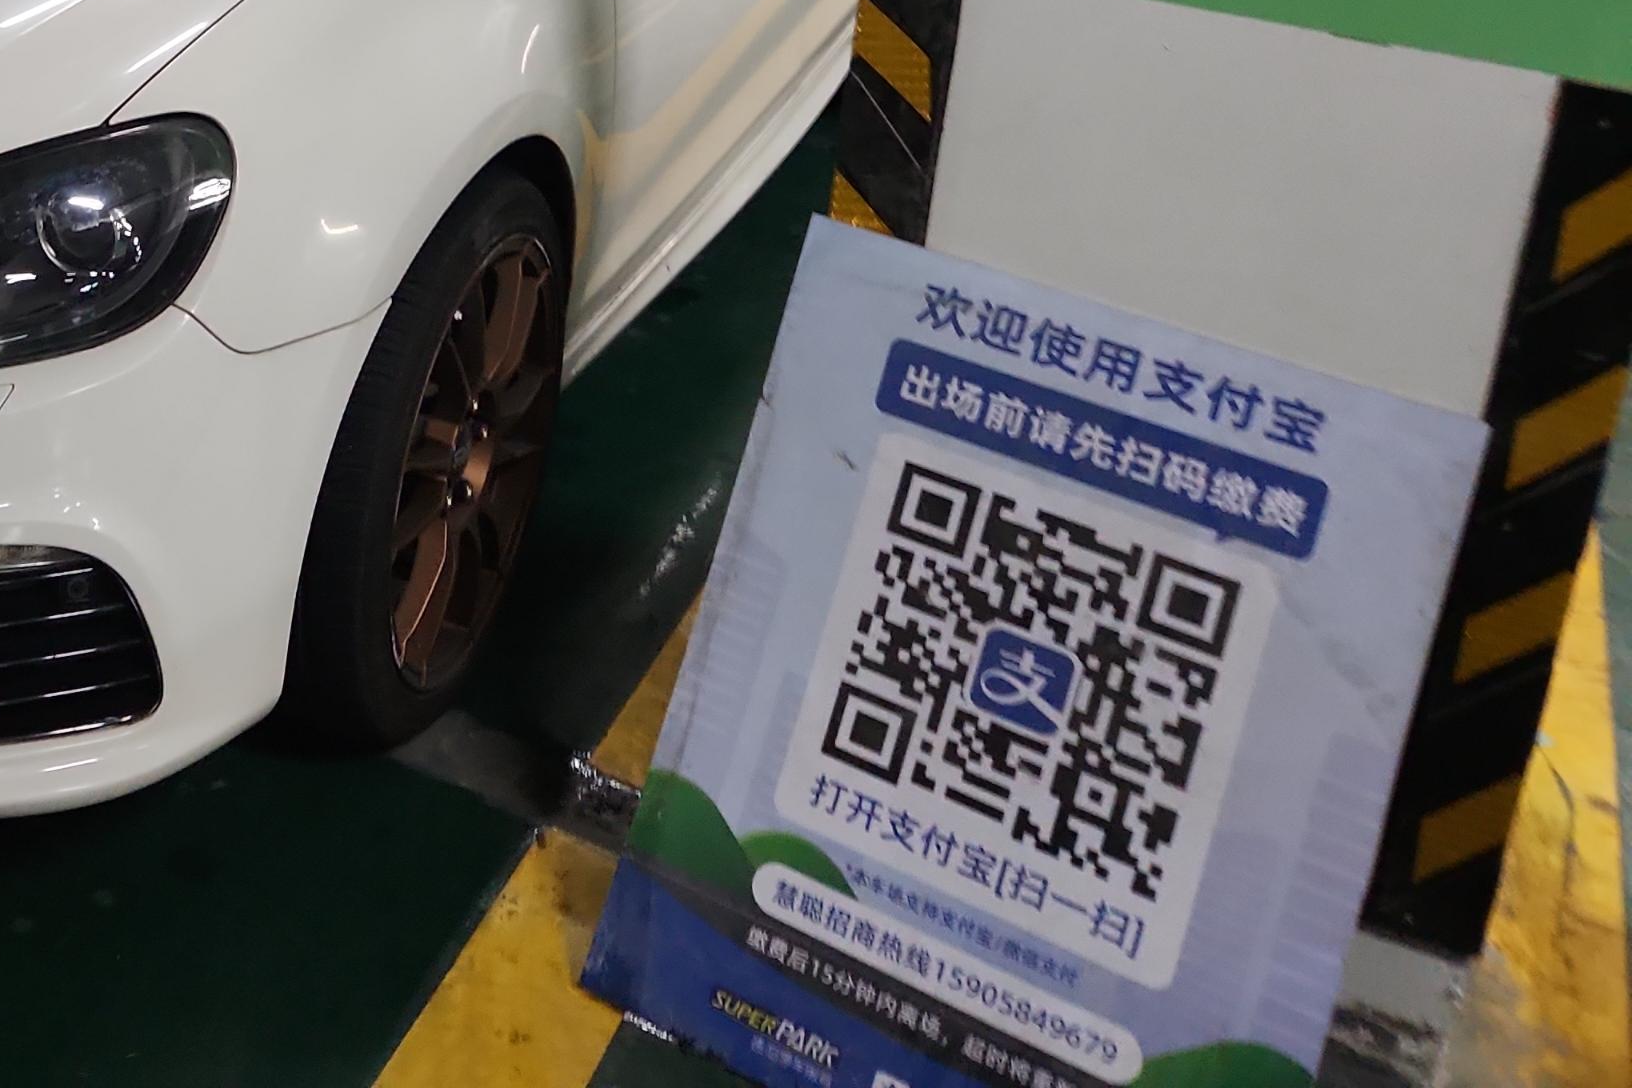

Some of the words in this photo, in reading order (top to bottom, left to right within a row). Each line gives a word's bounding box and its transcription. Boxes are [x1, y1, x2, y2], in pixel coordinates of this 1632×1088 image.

[898, 362, 1310, 540] 出场前请先扫码缴费
[917, 282, 1329, 456] 欢迎使用支付宝
[810, 774, 1145, 960] 打开支付宝[扫一扫]
[746, 923, 1077, 1088] 缴费后15分钟内离场，超时将重
[772, 876, 1119, 1065] 慧聪招商热线15905849679
